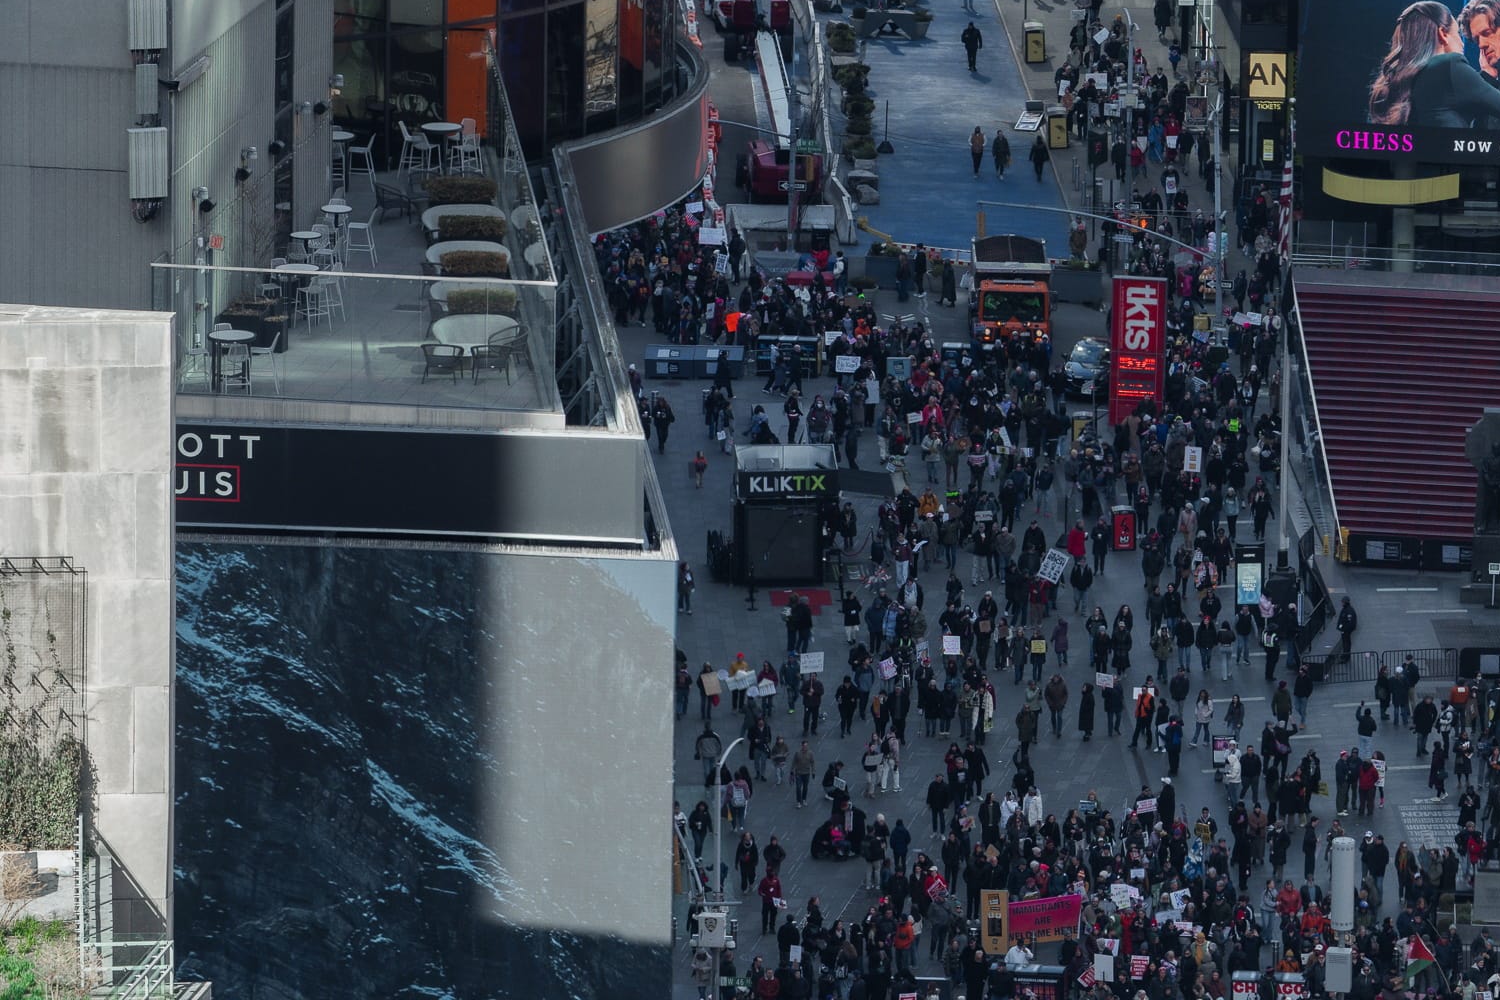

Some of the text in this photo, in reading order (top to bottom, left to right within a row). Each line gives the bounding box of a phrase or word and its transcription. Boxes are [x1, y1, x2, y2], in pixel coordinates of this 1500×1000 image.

[1256, 102, 1281, 111] TICKETS
[1335, 129, 1414, 153] CHESS
[1453, 139, 1492, 154] NOW
[1125, 284, 1159, 351] tkts
[177, 432, 261, 459] OTT
[749, 475, 826, 492] KLIKTIX
[1013, 902, 1072, 915] IMMIGRANTS
[1034, 916, 1053, 926] ARE
